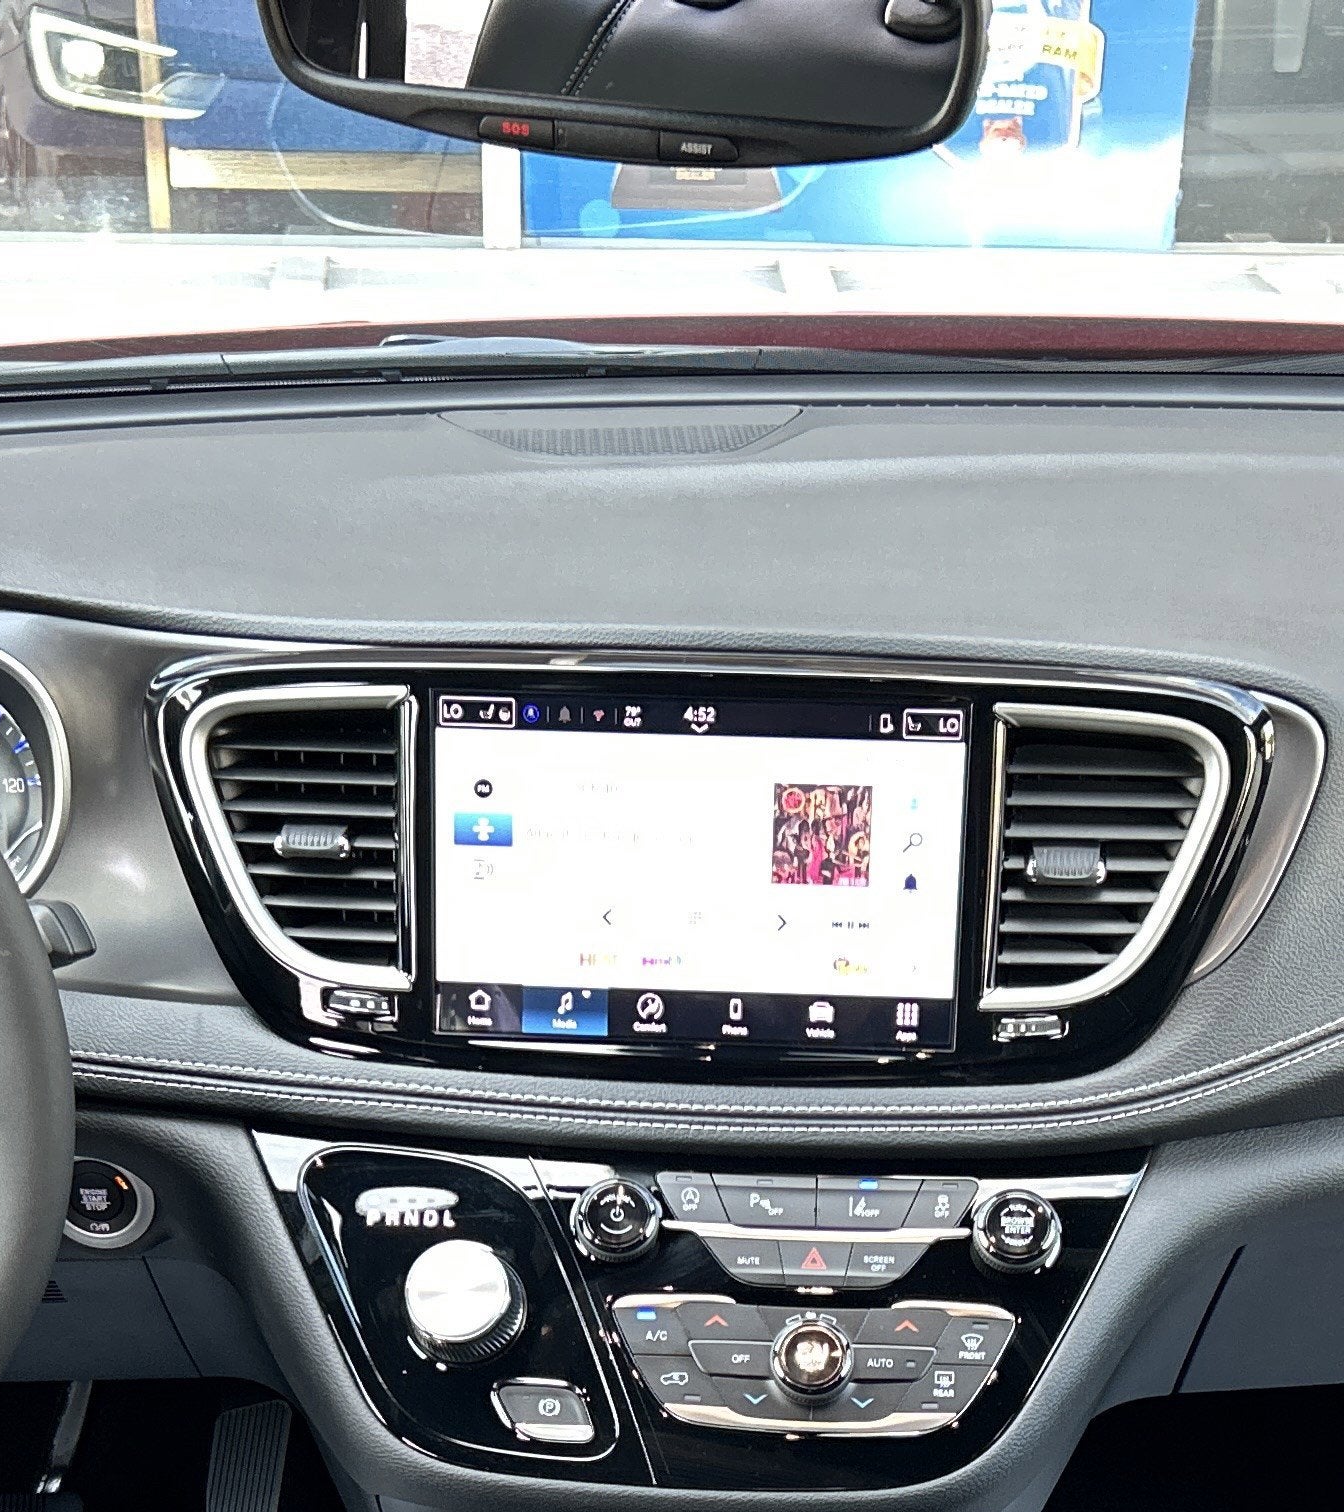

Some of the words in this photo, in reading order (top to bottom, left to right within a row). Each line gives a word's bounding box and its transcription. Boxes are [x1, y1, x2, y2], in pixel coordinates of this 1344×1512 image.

[501, 121, 530, 137] SOS
[443, 703, 464, 720] LO
[683, 705, 716, 722] 4:52
[938, 717, 959, 733] LO
[2, 777, 25, 793] 120
[863, 1254, 895, 1265] SCREEN
[871, 1263, 887, 1273] OFF
[645, 1330, 669, 1342] A/C
[731, 1353, 751, 1364] OFF
[866, 1357, 895, 1369] AUTO
